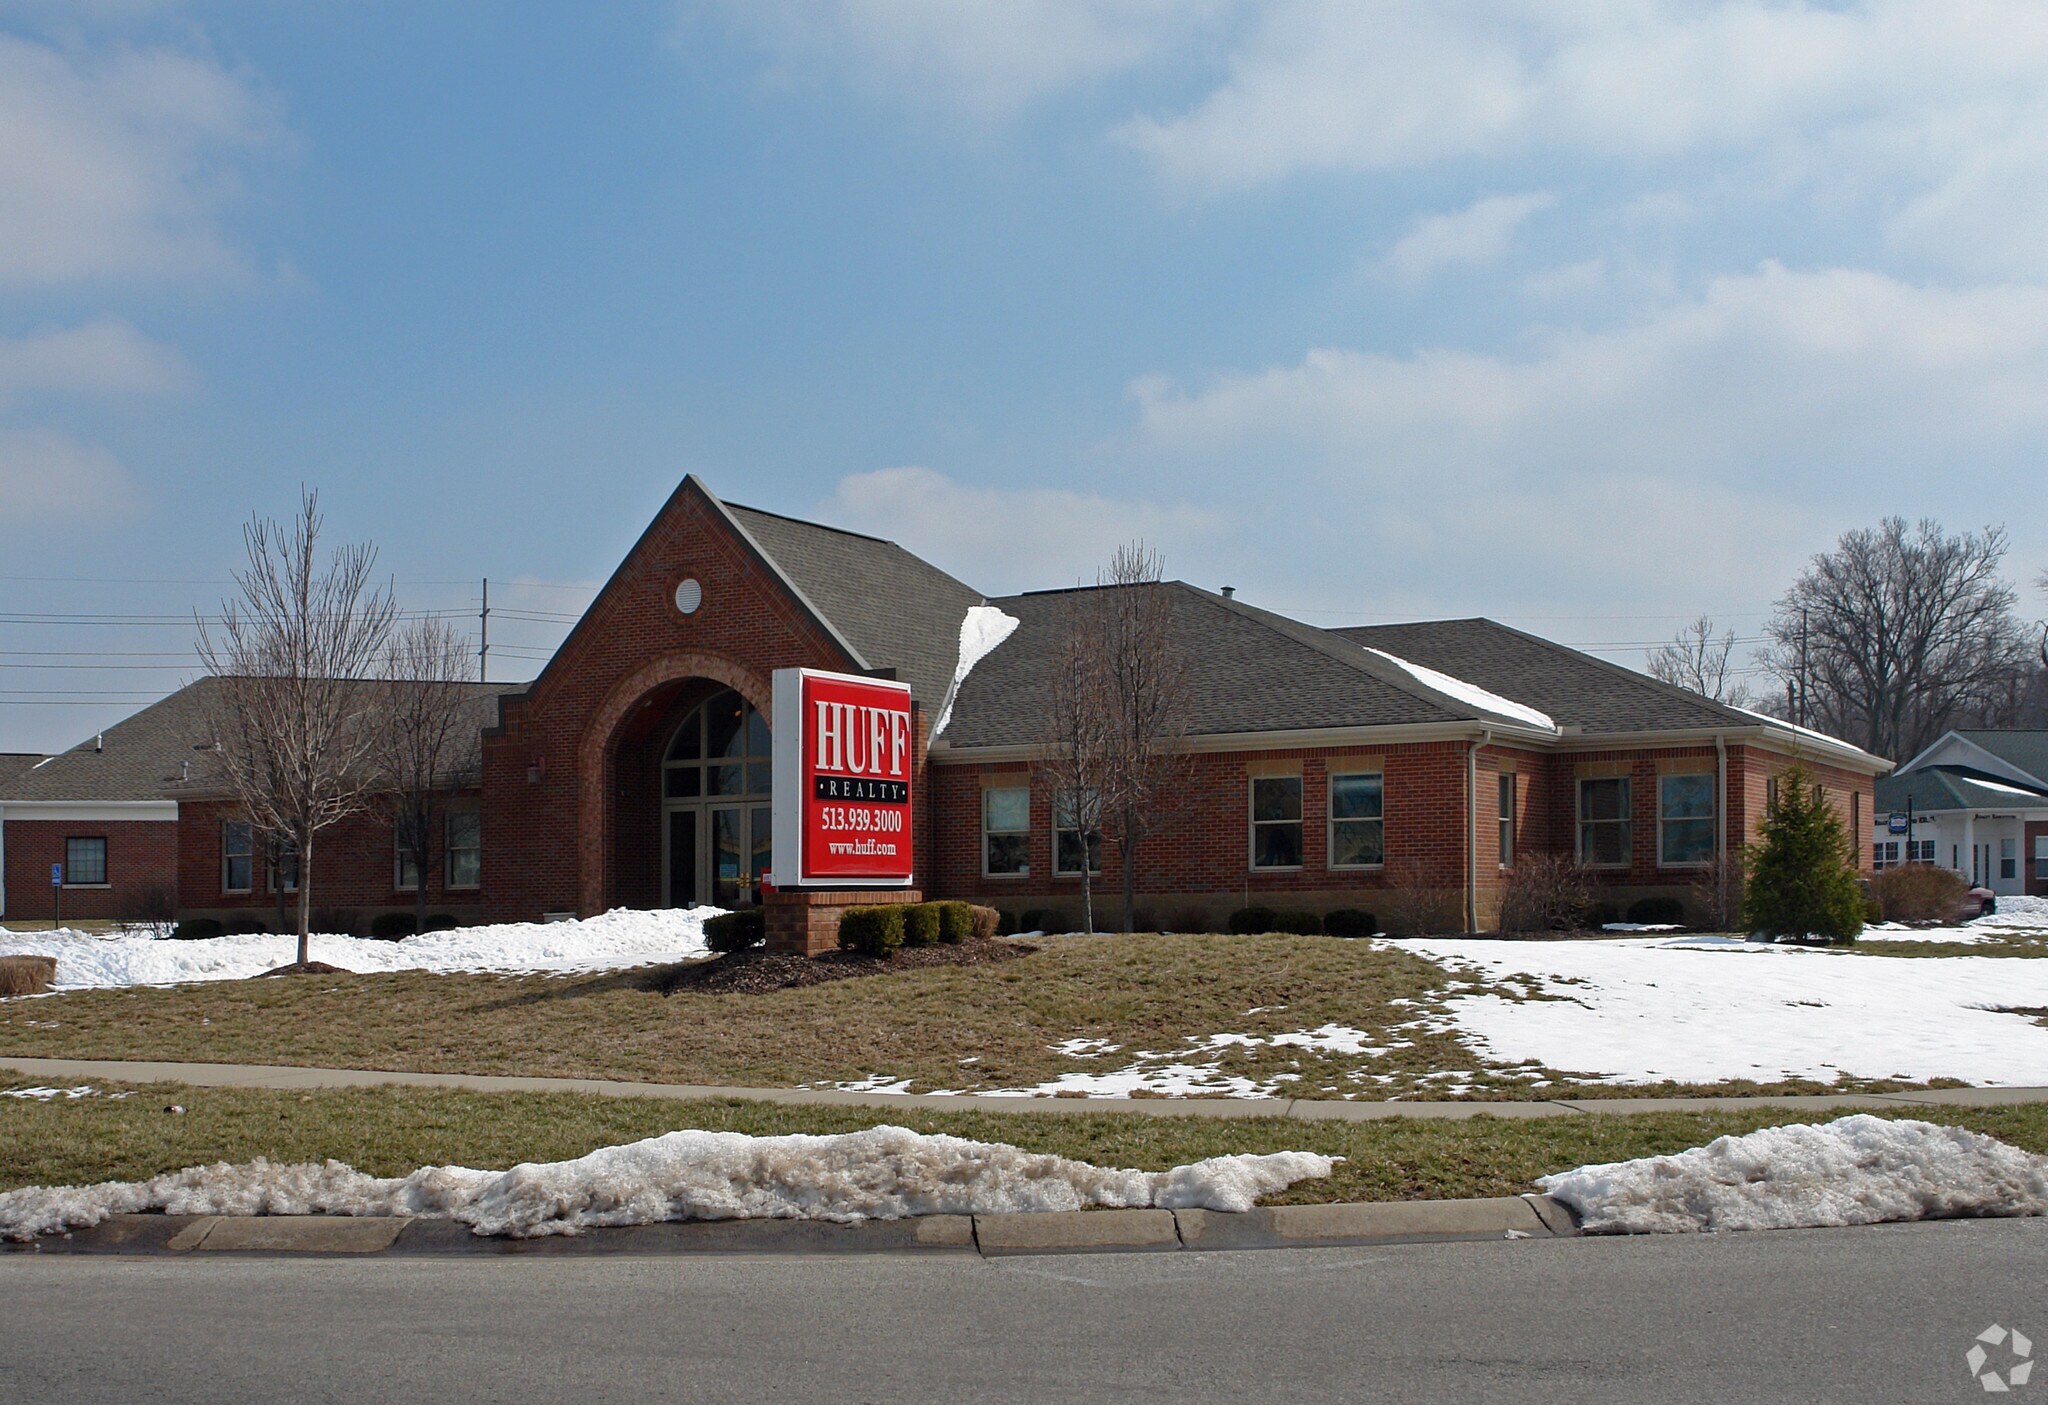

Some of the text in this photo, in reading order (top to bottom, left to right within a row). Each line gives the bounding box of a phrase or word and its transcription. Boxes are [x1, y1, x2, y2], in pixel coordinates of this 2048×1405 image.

[815, 700, 910, 775] HUFF
[830, 780, 899, 800] REALTY
[822, 807, 901, 832] 513.939.3000
[829, 839, 896, 855] www.huff.com
